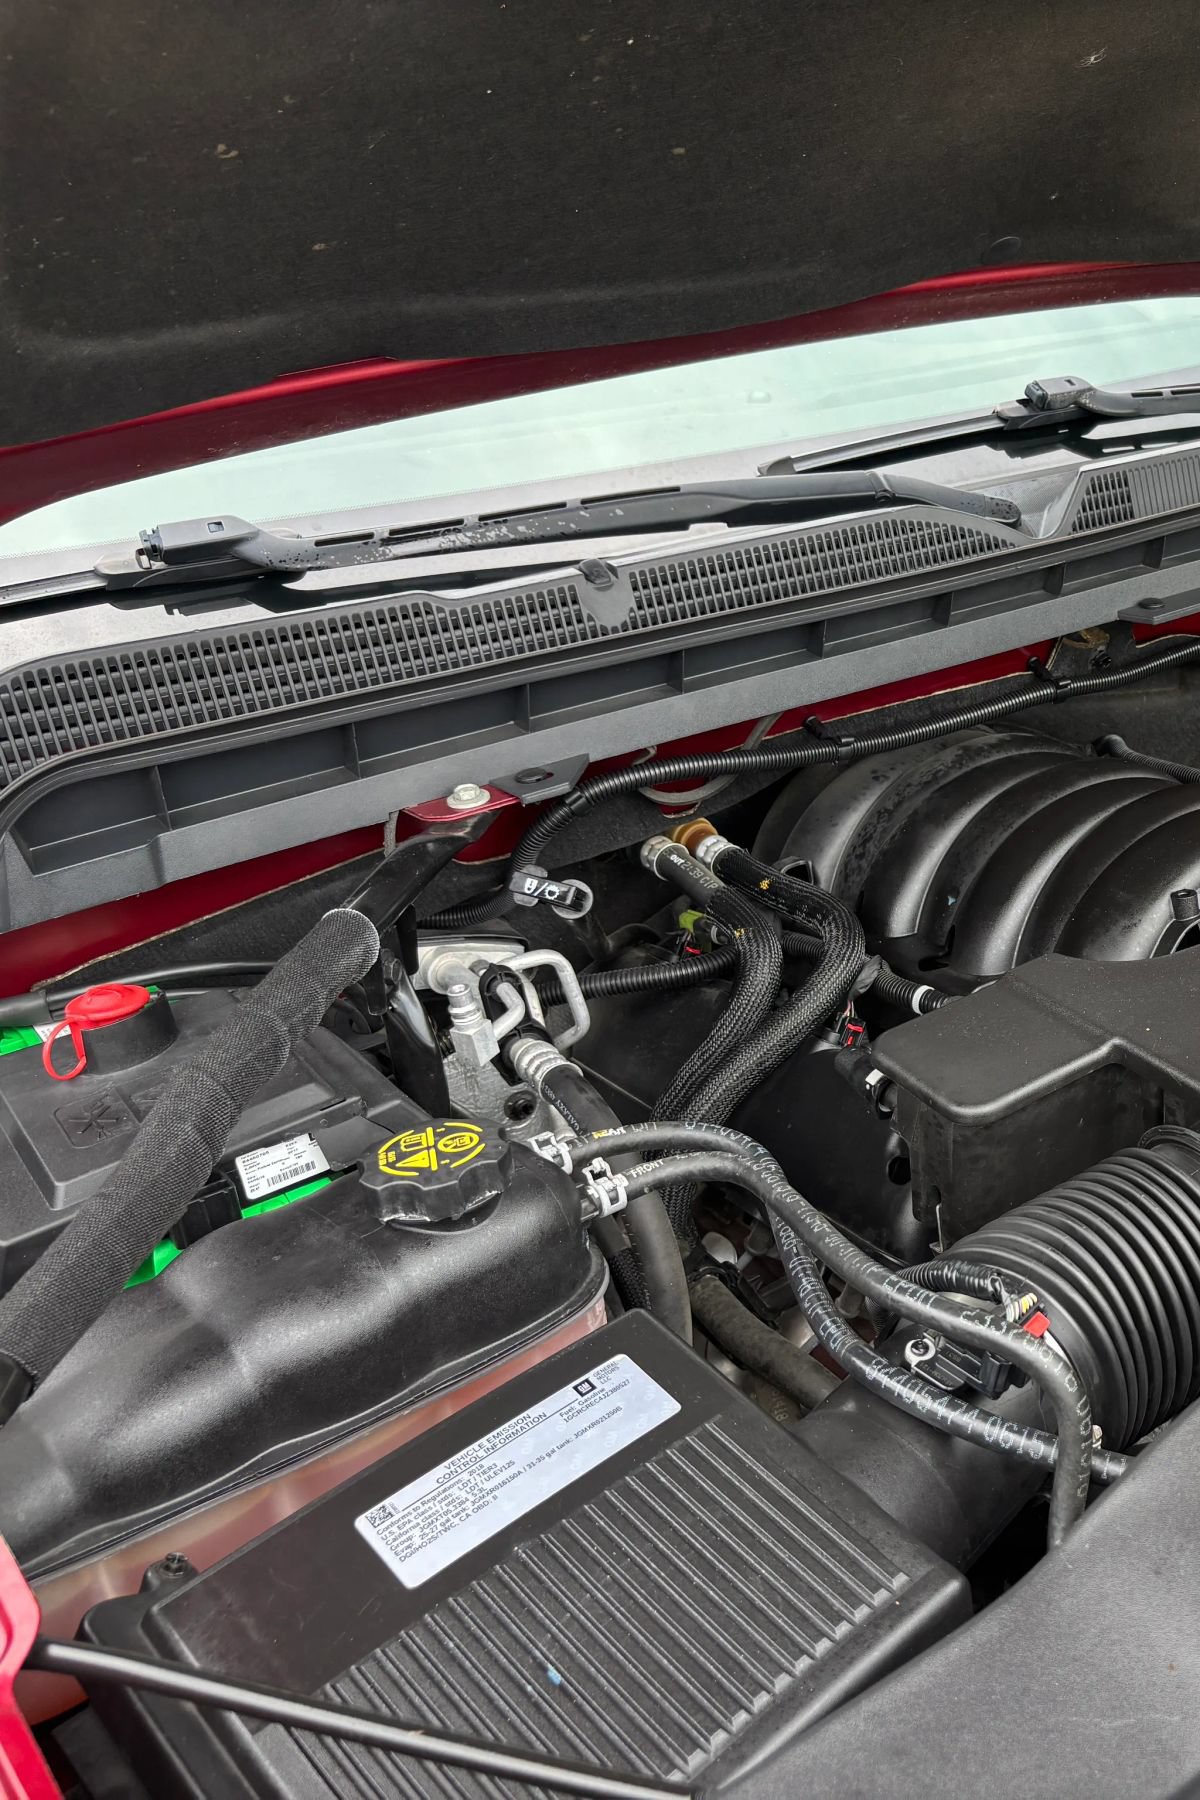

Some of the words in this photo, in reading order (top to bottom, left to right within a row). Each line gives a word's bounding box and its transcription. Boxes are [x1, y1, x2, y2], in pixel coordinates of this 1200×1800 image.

[553, 1099, 583, 1132] GALAXY
[632, 1159, 664, 1178] FRONT
[591, 1359, 619, 1378] GENERAL
[595, 1364, 620, 1382] MOTORS
[598, 1375, 612, 1385] LLC
[558, 1404, 577, 1418] Fuel:
[576, 1385, 606, 1407] Gasoline
[576, 1381, 592, 1393] GM
[433, 1451, 484, 1486] CONTROL
[481, 1410, 549, 1455] INFORMATION
[442, 1441, 487, 1472] VEHICLE
[484, 1412, 533, 1445] EMISSION
[374, 1509, 413, 1536] Conforms
[410, 1503, 422, 1513] to
[419, 1475, 467, 1508] Regulations:
[466, 1462, 486, 1477] 2018
[379, 1526, 398, 1542] U.S.
[395, 1516, 414, 1531] EPA
[411, 1503, 434, 1520] class
[435, 1489, 456, 1505] stds:
[456, 1478, 474, 1491] LDT
[475, 1461, 499, 1479] TIER3
[383, 1520, 421, 1547] California
[419, 1507, 441, 1524] class
[442, 1492, 463, 1508] stds:
[463, 1481, 481, 1495] LDT
[482, 1458, 516, 1483] ULEV125
[393, 1539, 417, 1558] Evap:
[417, 1524, 440, 1541] 25-27
[438, 1516, 453, 1528] gal
[449, 1504, 470, 1520] tank:
[525, 1454, 546, 1470] 31-35
[543, 1447, 558, 1458] gal
[554, 1435, 574, 1451] tank:
[457, 1511, 472, 1523] CA
[388, 1531, 417, 1553] Group:
